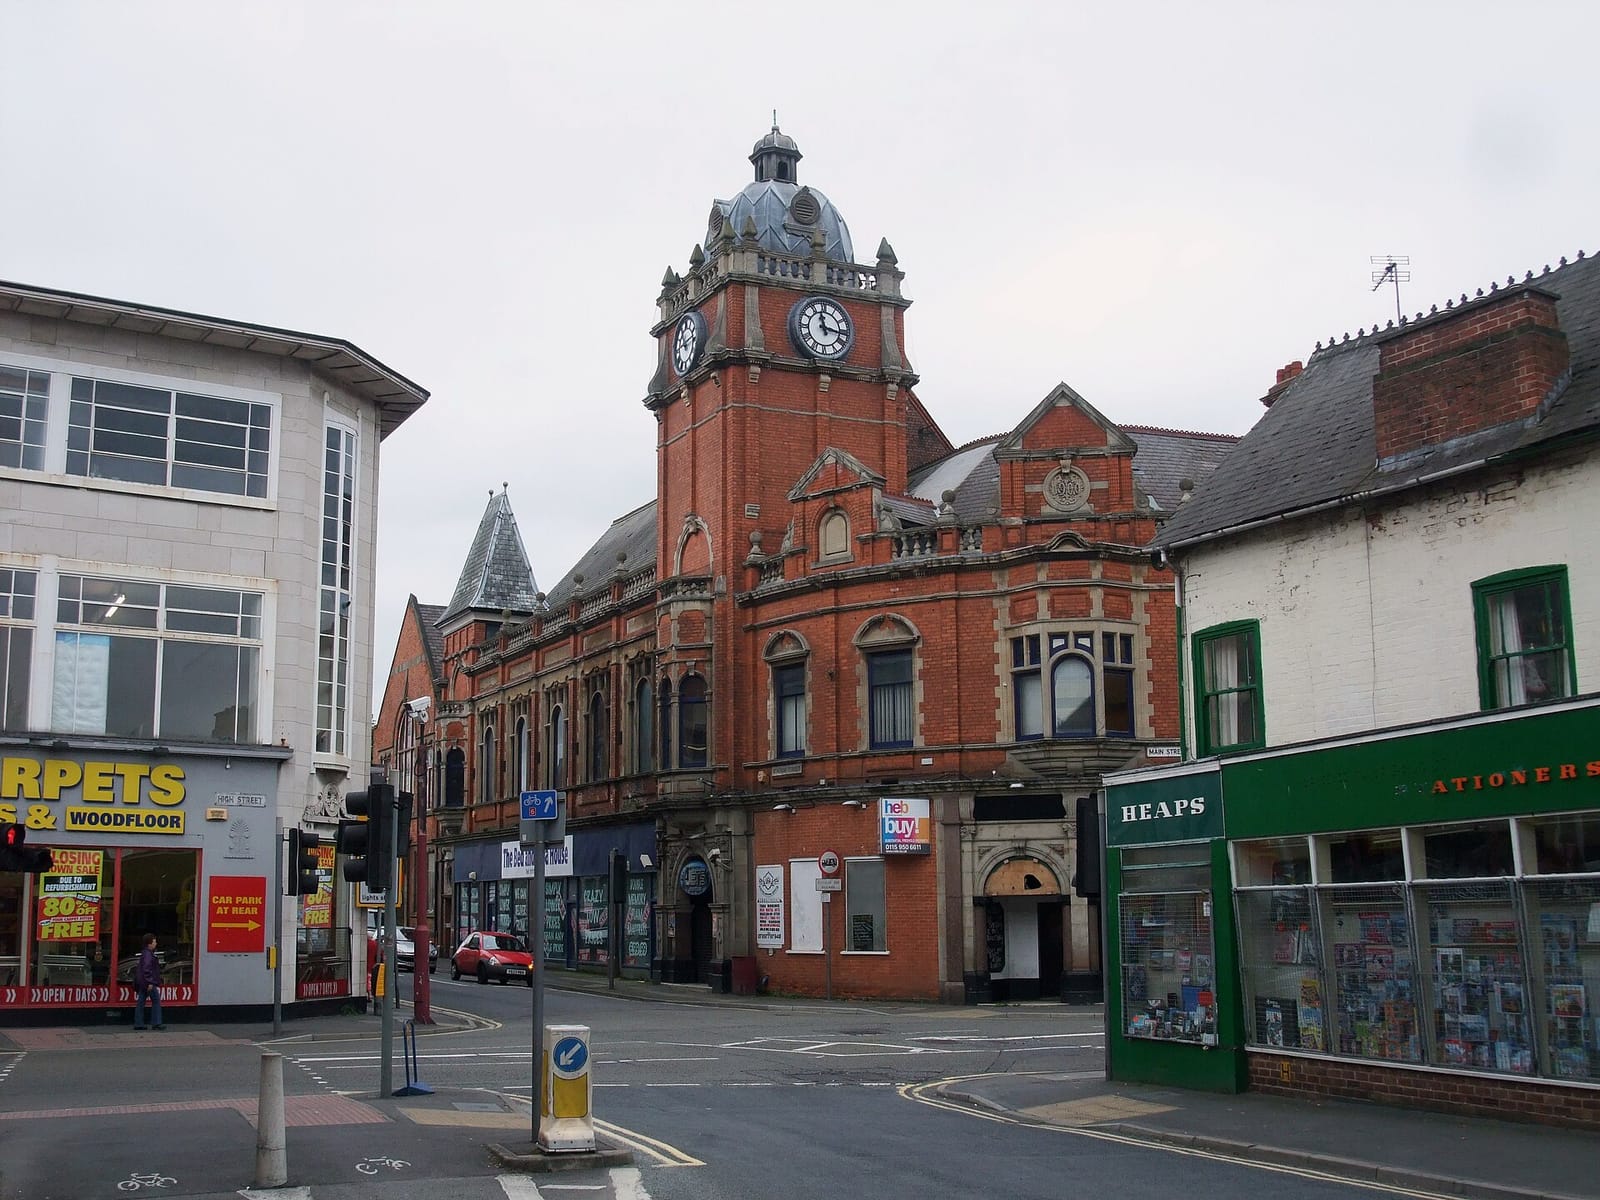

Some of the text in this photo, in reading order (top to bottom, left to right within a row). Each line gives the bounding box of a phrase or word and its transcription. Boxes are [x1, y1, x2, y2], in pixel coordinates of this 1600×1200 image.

[217, 795, 262, 805] HIGH STREET
[885, 800, 908, 814] heb
[1121, 796, 1205, 822] HEAPS
[25, 804, 57, 830] &
[70, 811, 181, 829] WOODFLOOR
[885, 817, 919, 838] buy!
[51, 850, 101, 865] LOSING
[503, 848, 513, 868] The
[51, 864, 100, 874] OWN SALE
[212, 896, 262, 905] CAR PARK
[584, 889, 604, 903] CRAZY
[76, 907, 98, 916] OFF
[216, 906, 258, 915] AT REAR
[305, 909, 329, 925] FREE
[41, 921, 95, 939] FREE
[43, 988, 97, 1002] OPEN 7 DAYS
[1281, 1063, 1290, 1080] H
